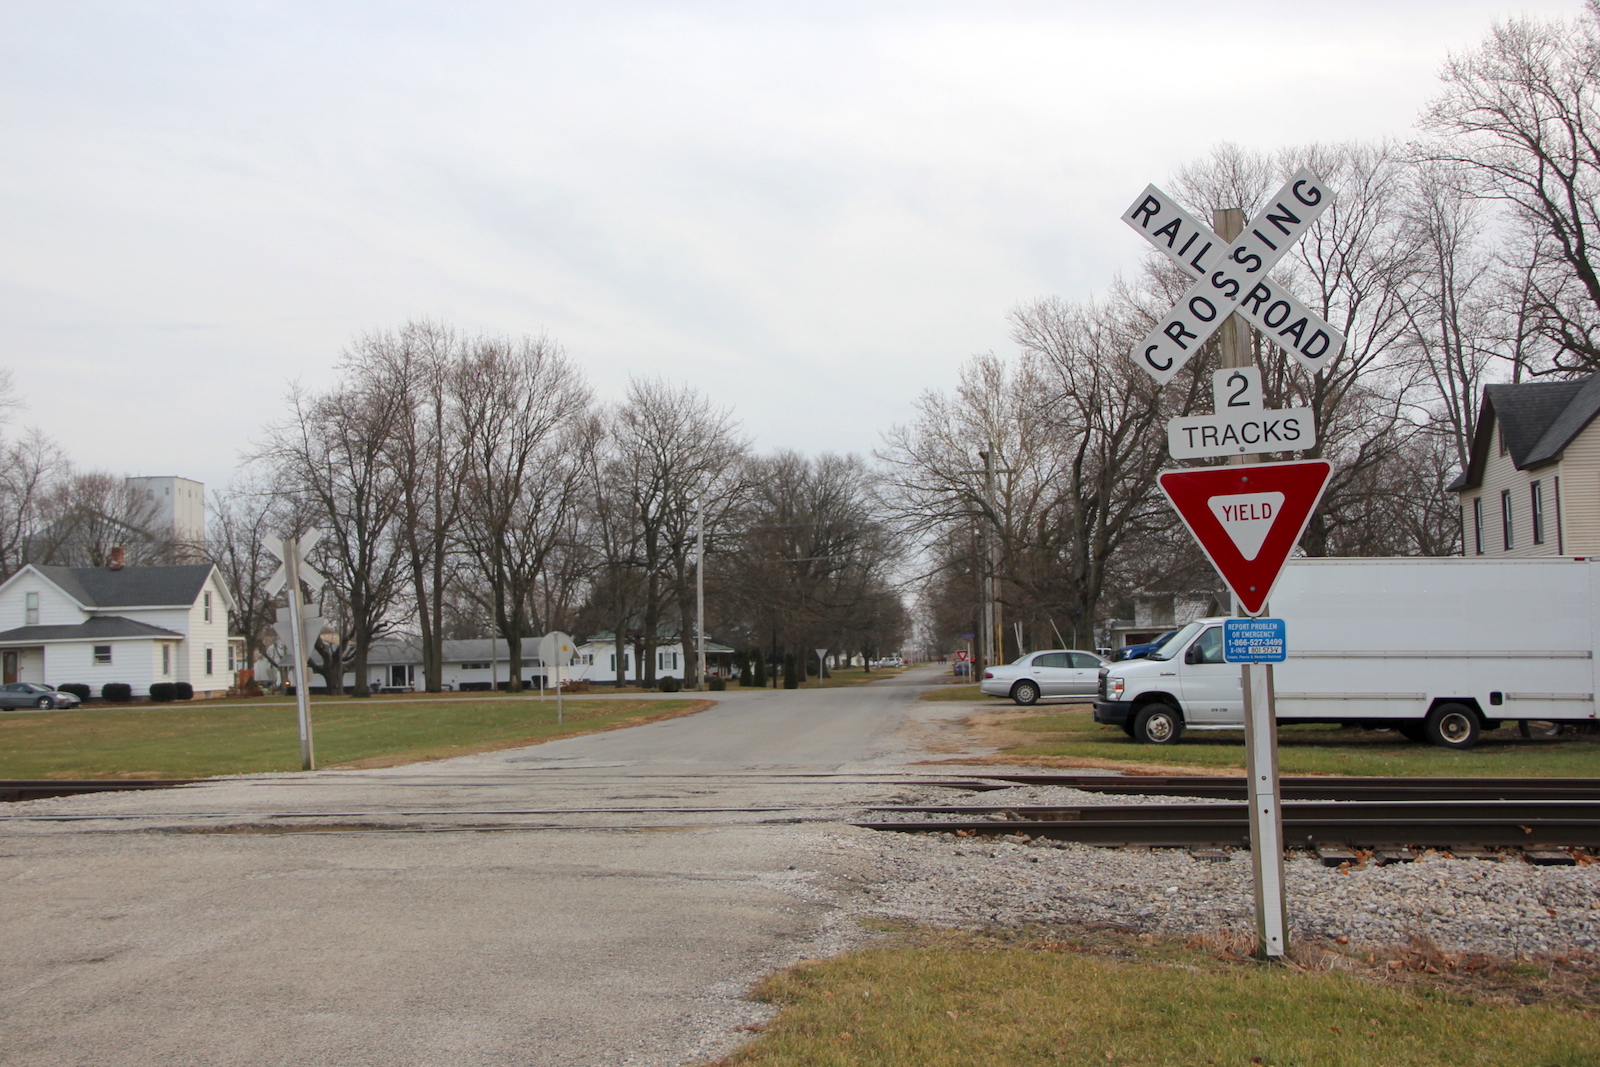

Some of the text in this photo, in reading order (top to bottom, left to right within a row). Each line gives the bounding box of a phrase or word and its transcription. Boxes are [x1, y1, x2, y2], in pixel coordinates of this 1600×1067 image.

[1130, 194, 1331, 359] RAIL ROAD
[1144, 179, 1323, 372] CROSSING
[1226, 373, 1250, 408] 2
[1181, 418, 1301, 449] TRACKS
[1222, 503, 1272, 522] YIELD
